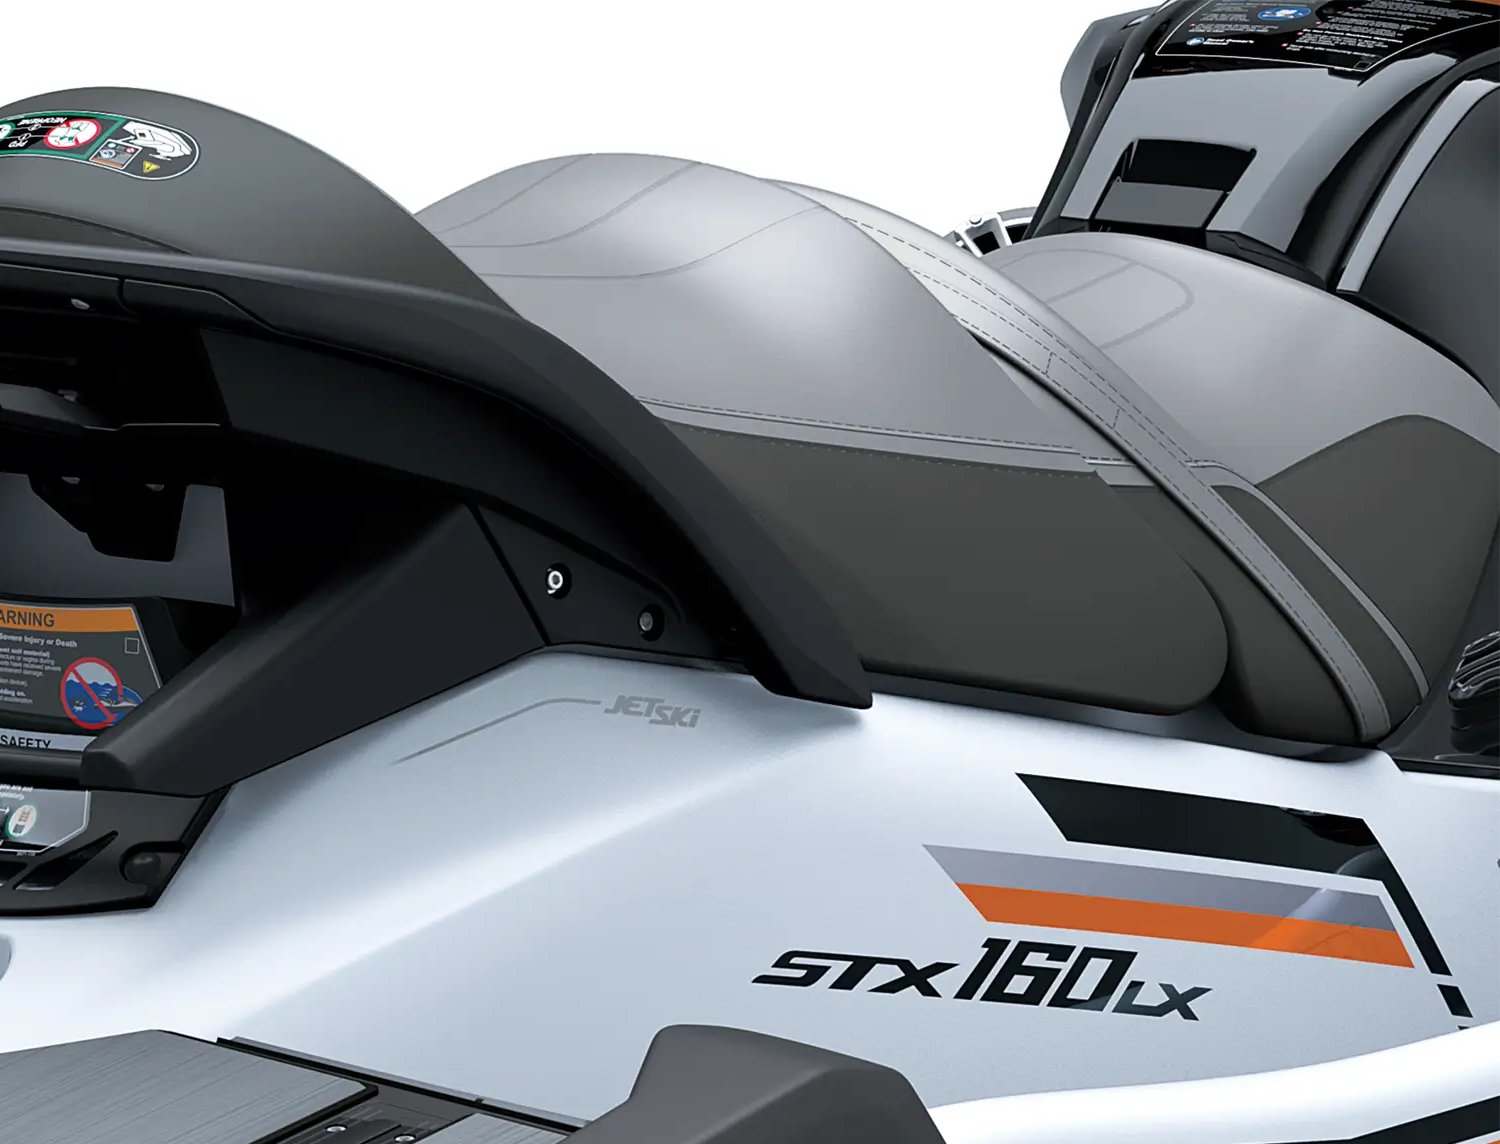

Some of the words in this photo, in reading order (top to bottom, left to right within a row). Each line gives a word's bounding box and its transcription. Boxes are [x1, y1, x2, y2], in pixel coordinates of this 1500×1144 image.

[0, 633, 23, 642] Severe
[24, 636, 45, 646] Injury
[56, 639, 78, 648] Death
[0, 735, 52, 749] SAFETY
[752, 949, 960, 999] STX
